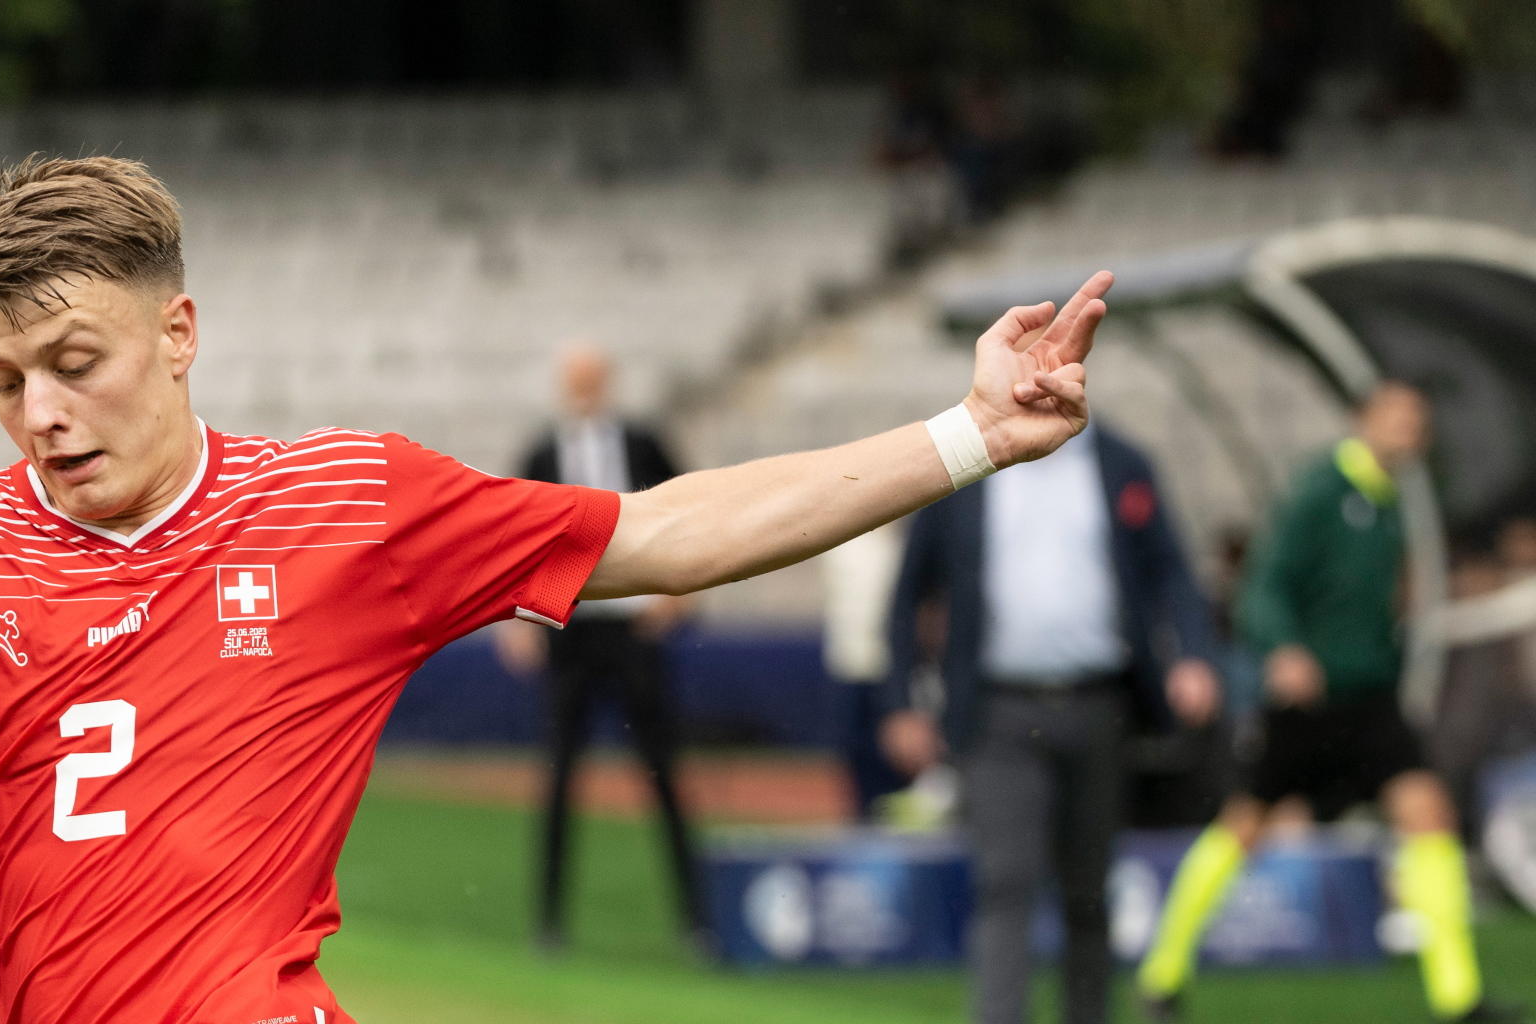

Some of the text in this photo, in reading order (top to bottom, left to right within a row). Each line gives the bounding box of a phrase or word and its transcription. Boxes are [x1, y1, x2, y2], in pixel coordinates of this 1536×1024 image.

[87, 610, 143, 648] PUMA
[227, 627, 268, 638] 25.06.2023
[224, 636, 242, 650] SUI
[251, 635, 269, 648] ITA
[220, 647, 273, 659] CLUJ-NAPOCA
[52, 698, 137, 842] 2
